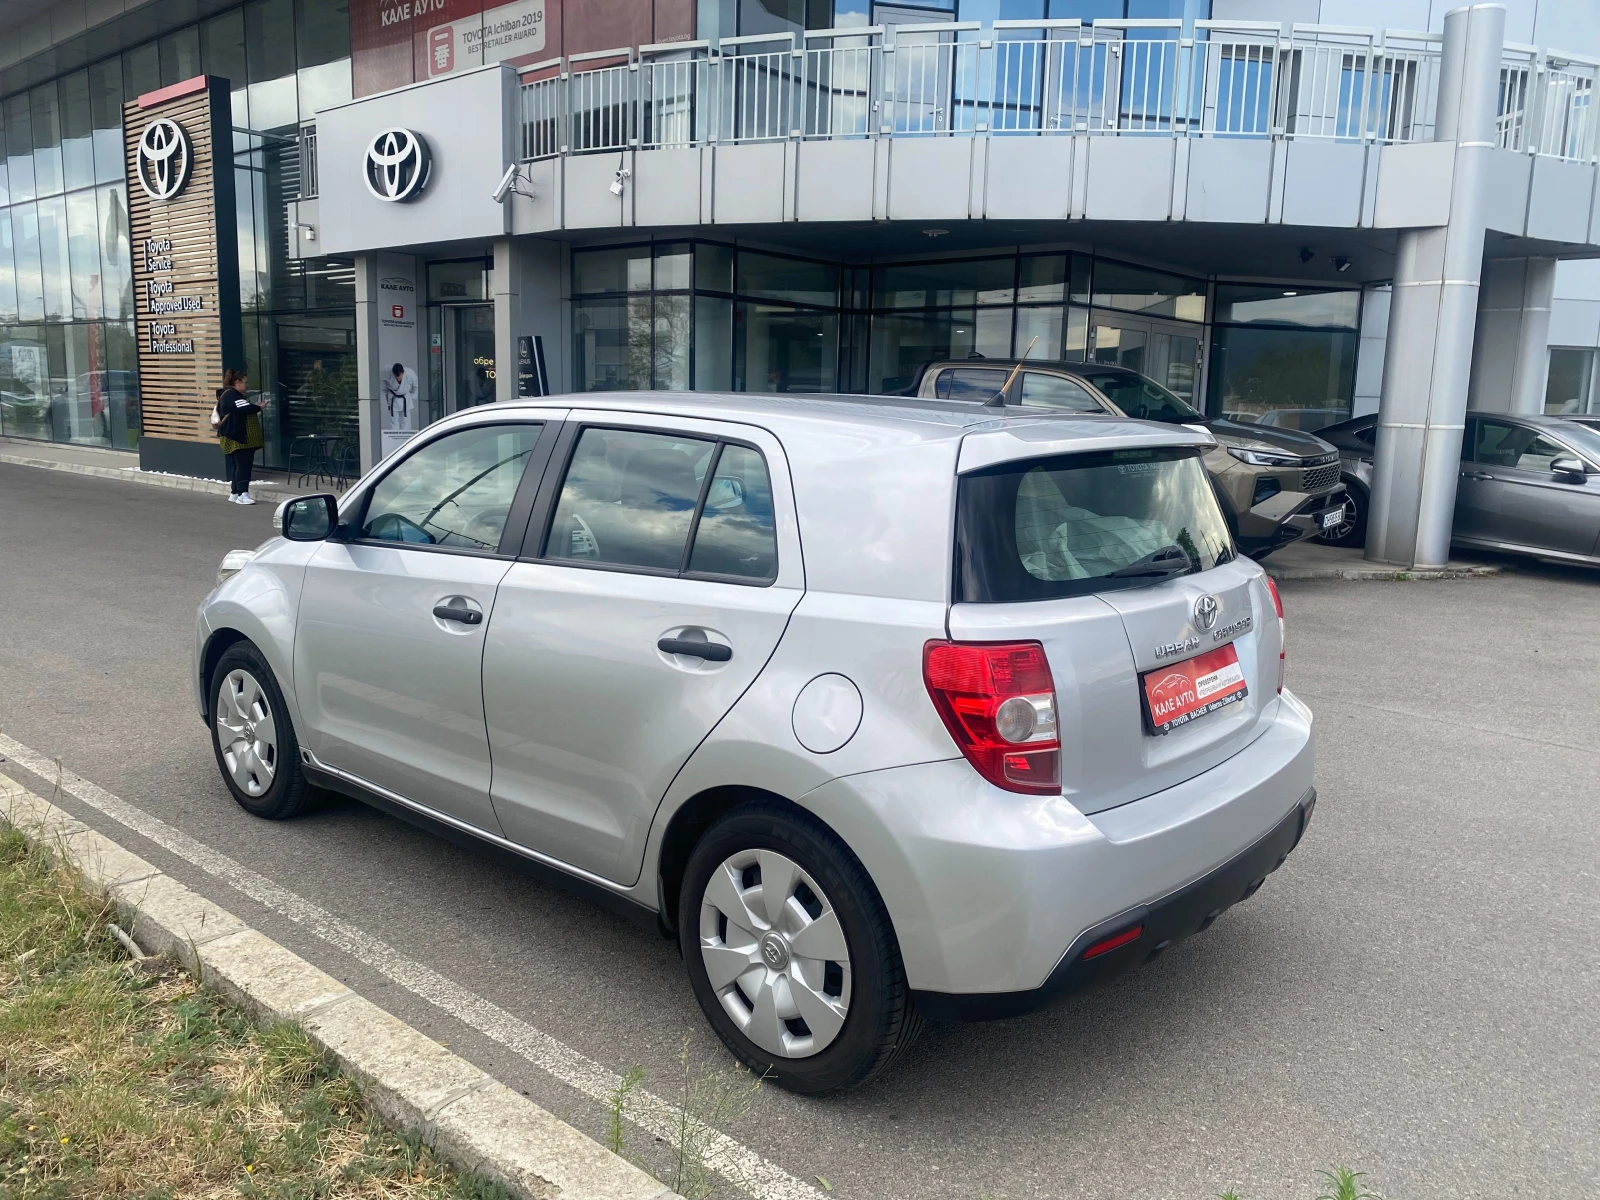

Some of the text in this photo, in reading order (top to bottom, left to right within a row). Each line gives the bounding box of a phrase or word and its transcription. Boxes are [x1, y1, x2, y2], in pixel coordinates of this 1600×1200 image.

[462, 10, 543, 44] TOYOTA Ichiban 2019
[467, 27, 537, 54] BEST RETAILER AWARD
[146, 239, 171, 254] Toyota
[148, 258, 172, 271] Service
[149, 281, 173, 296] Toyota
[151, 296, 201, 313] Approved Used
[151, 322, 175, 337] Toyota
[152, 340, 193, 353] Professional
[1125, 463, 1149, 472] TOYOTA
[1154, 637, 1200, 659] URBAN
[1171, 715, 1190, 728] TOYOTA
[1190, 706, 1208, 719] BACHER
